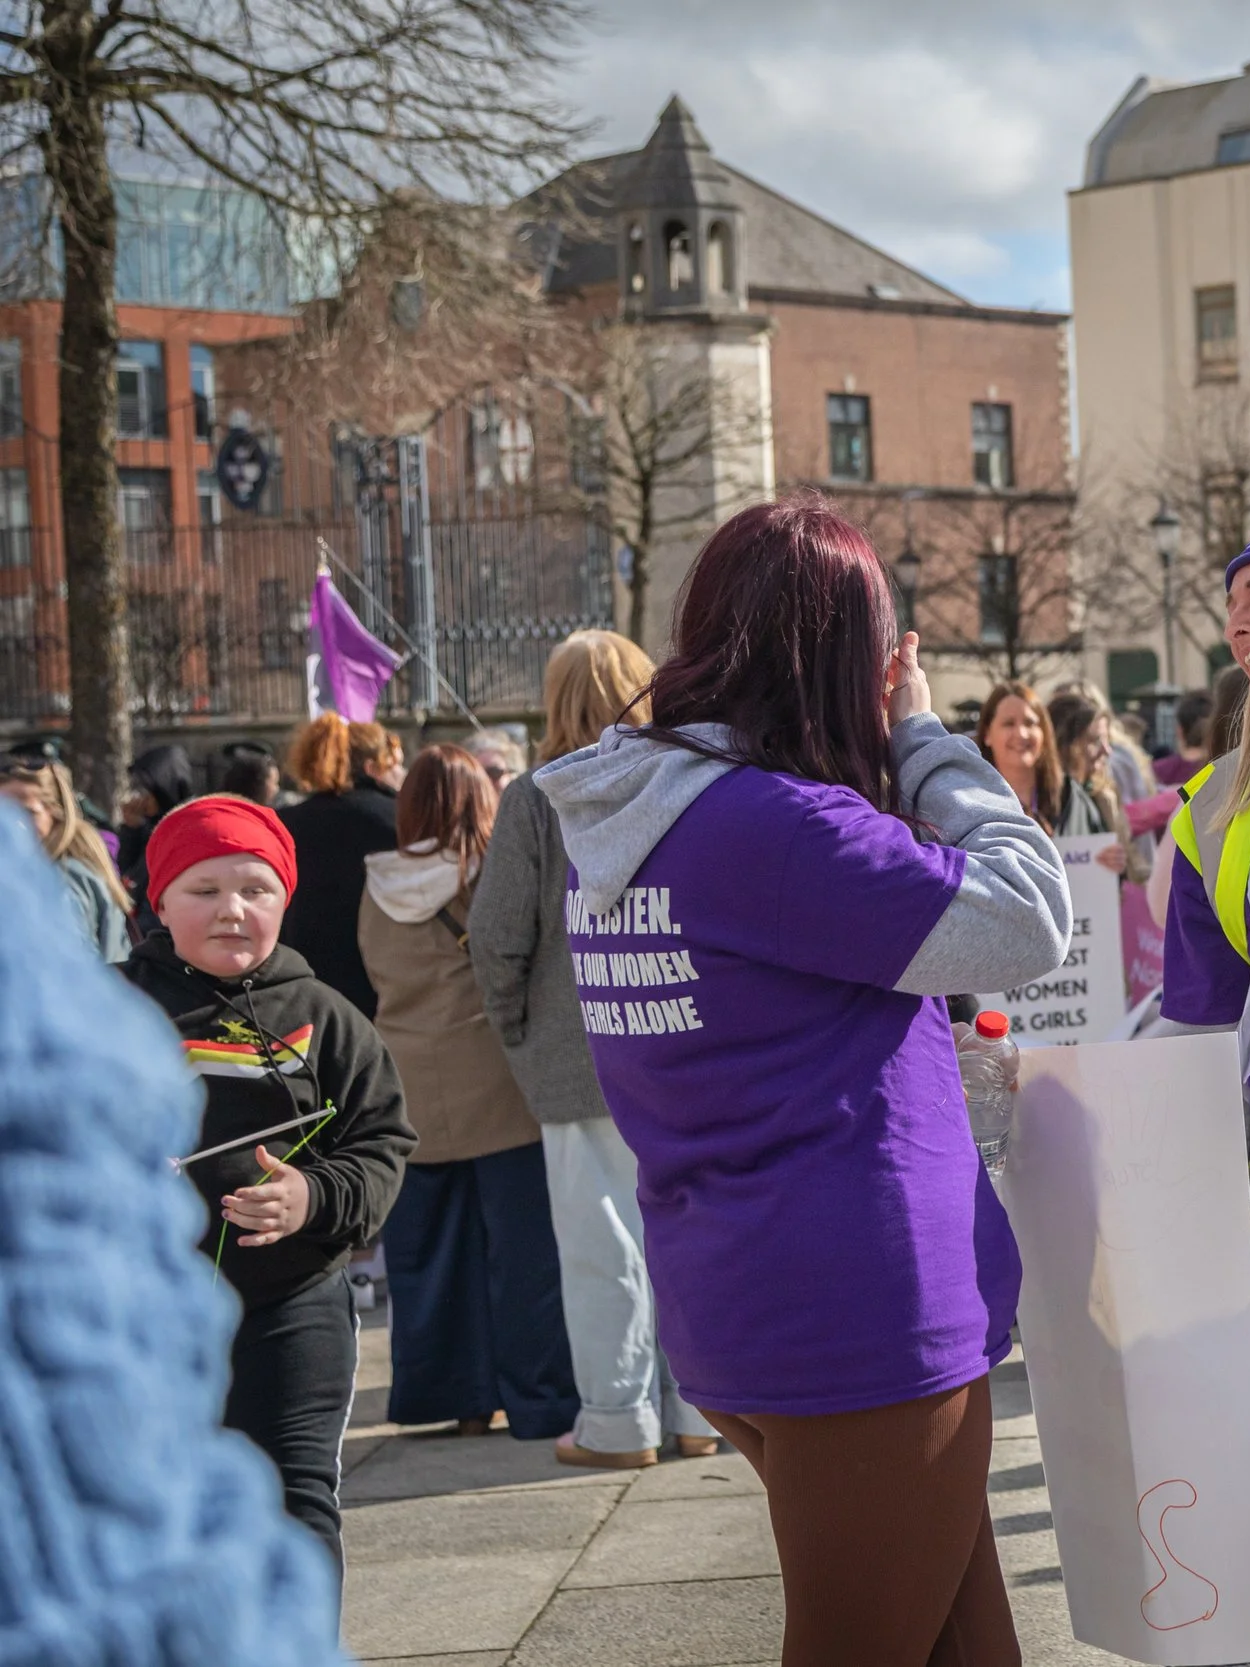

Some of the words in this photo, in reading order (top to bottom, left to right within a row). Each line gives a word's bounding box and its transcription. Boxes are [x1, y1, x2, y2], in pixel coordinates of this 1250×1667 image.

[1064, 851, 1091, 864] Aid
[583, 952, 610, 987] OUR
[609, 949, 700, 987] WOMEN
[1004, 978, 1088, 1003] WOMEN
[586, 1000, 625, 1035] GIRLS
[624, 996, 704, 1035] ALONE
[1010, 1015, 1025, 1033] &
[1030, 1007, 1087, 1031] GIRLS
